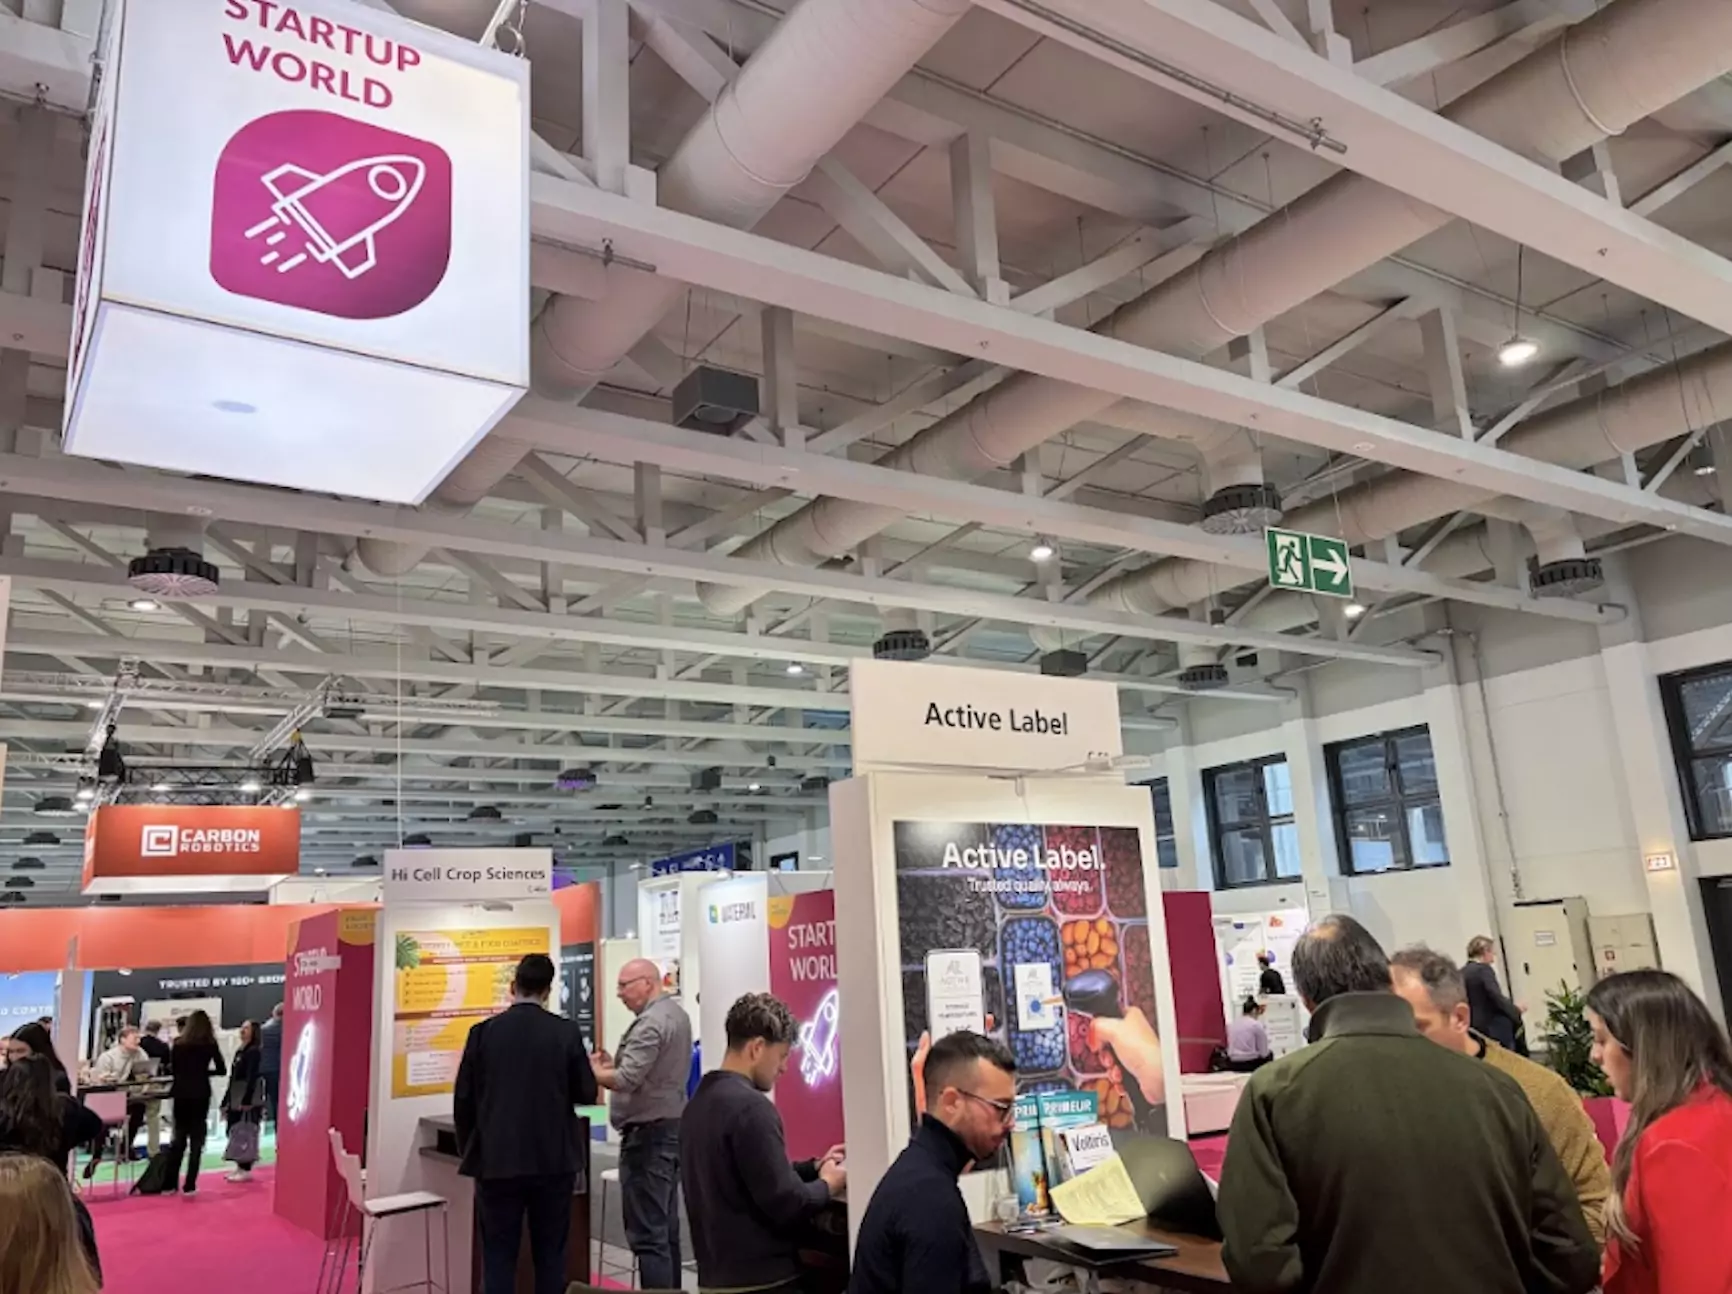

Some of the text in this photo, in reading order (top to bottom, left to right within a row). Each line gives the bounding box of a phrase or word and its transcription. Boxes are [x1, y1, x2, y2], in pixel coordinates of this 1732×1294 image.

[225, 0, 420, 71] STARTUP
[222, 33, 393, 109] WORLD
[925, 702, 1068, 735] Active Label
[180, 842, 260, 852] ROBOTICS
[181, 829, 260, 842] CARBON
[942, 842, 1106, 870] Active Label.
[392, 867, 545, 883] Hi Cell Crop Sciences
[967, 877, 1012, 892] Trusted
[788, 920, 836, 950] START
[789, 954, 837, 981] WORL
[159, 978, 210, 989] TRUSTED
[212, 978, 228, 987] BY
[292, 984, 321, 1011] WORLD
[1043, 1100, 1092, 1115] PRIMEUR
